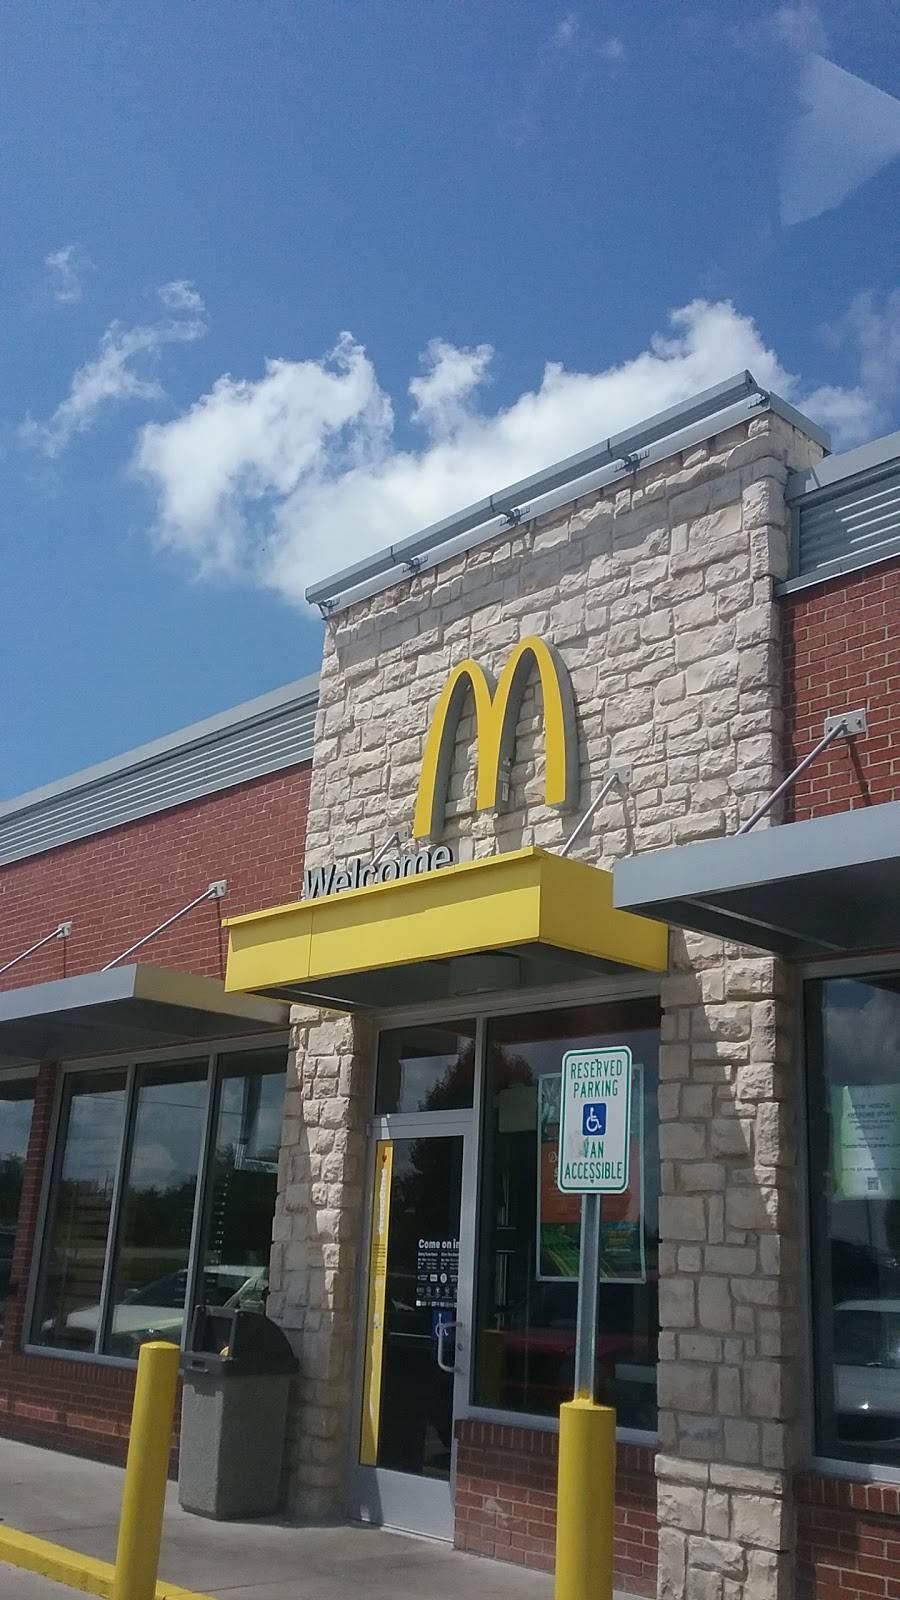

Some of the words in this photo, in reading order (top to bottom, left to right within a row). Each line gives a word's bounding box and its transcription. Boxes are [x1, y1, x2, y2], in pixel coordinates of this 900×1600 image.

[304, 845, 454, 899] Welcome
[571, 1059, 622, 1080] RESERVED
[573, 1080, 618, 1098] PARKING
[583, 1141, 604, 1158] VAN
[565, 1162, 623, 1179] ACCESSIBLE
[418, 1239, 440, 1249] Come
[442, 1241, 452, 1249] on
